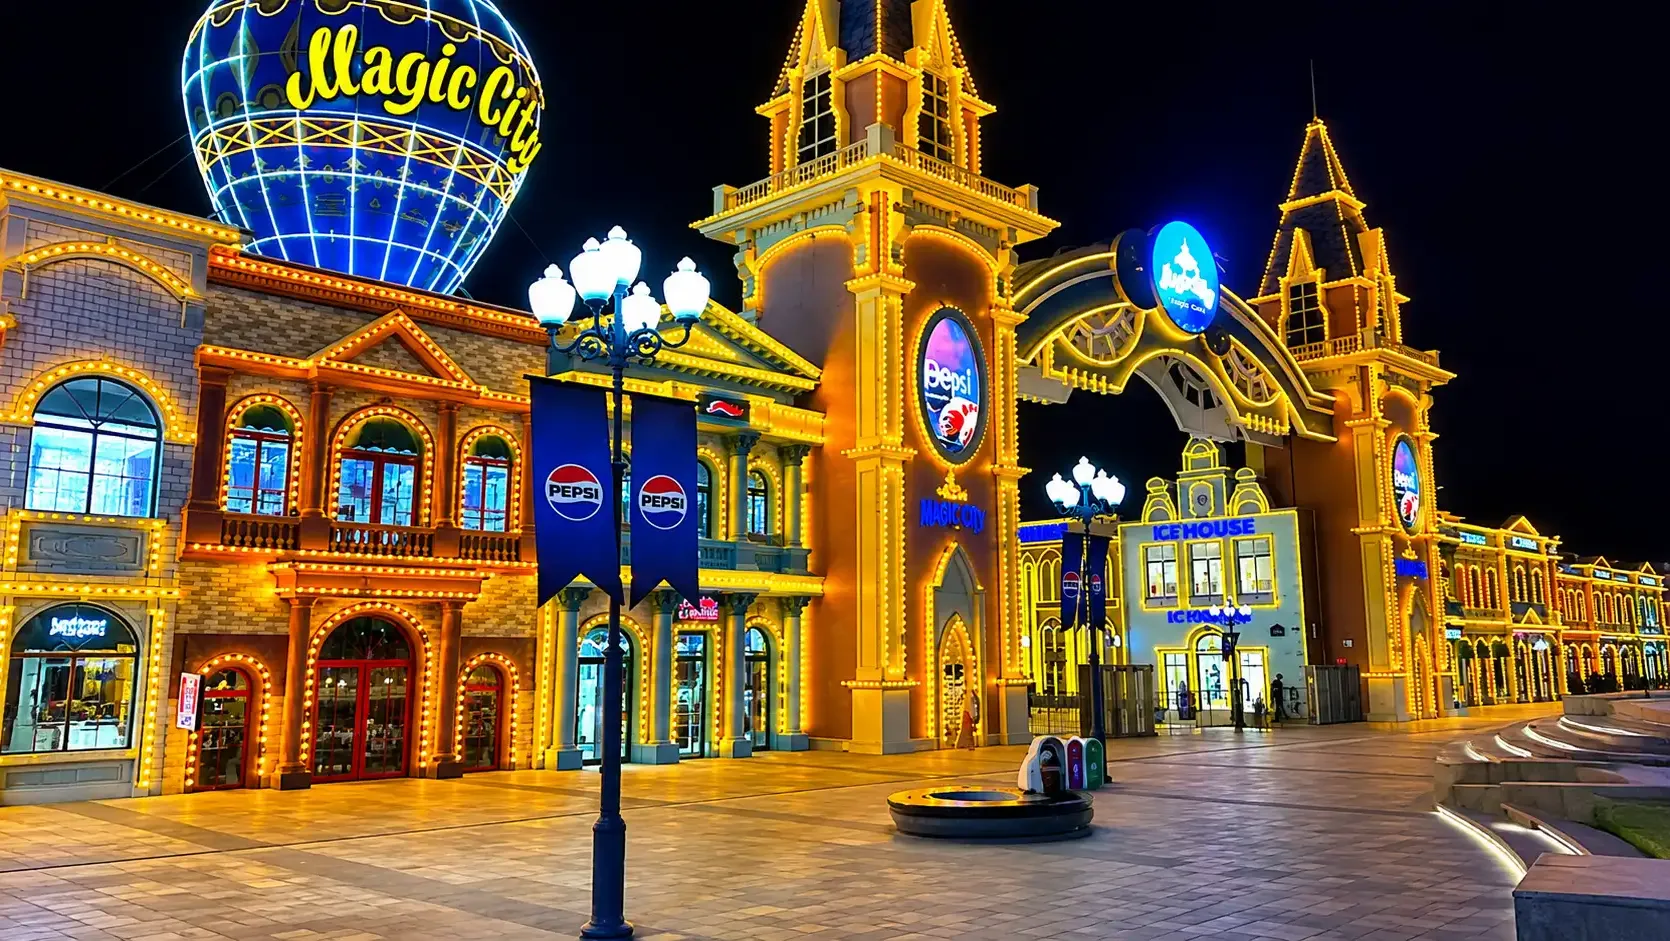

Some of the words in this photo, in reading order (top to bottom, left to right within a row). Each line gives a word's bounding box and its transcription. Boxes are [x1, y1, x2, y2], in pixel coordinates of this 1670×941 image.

[286, 24, 477, 115] Magic
[479, 66, 542, 174] City
[549, 484, 599, 500] PEPSI
[642, 494, 684, 510] PEPSI
[920, 499, 961, 526] MAGIC
[1153, 525, 1180, 540] ICE
[1183, 518, 1255, 539] HOUSE
